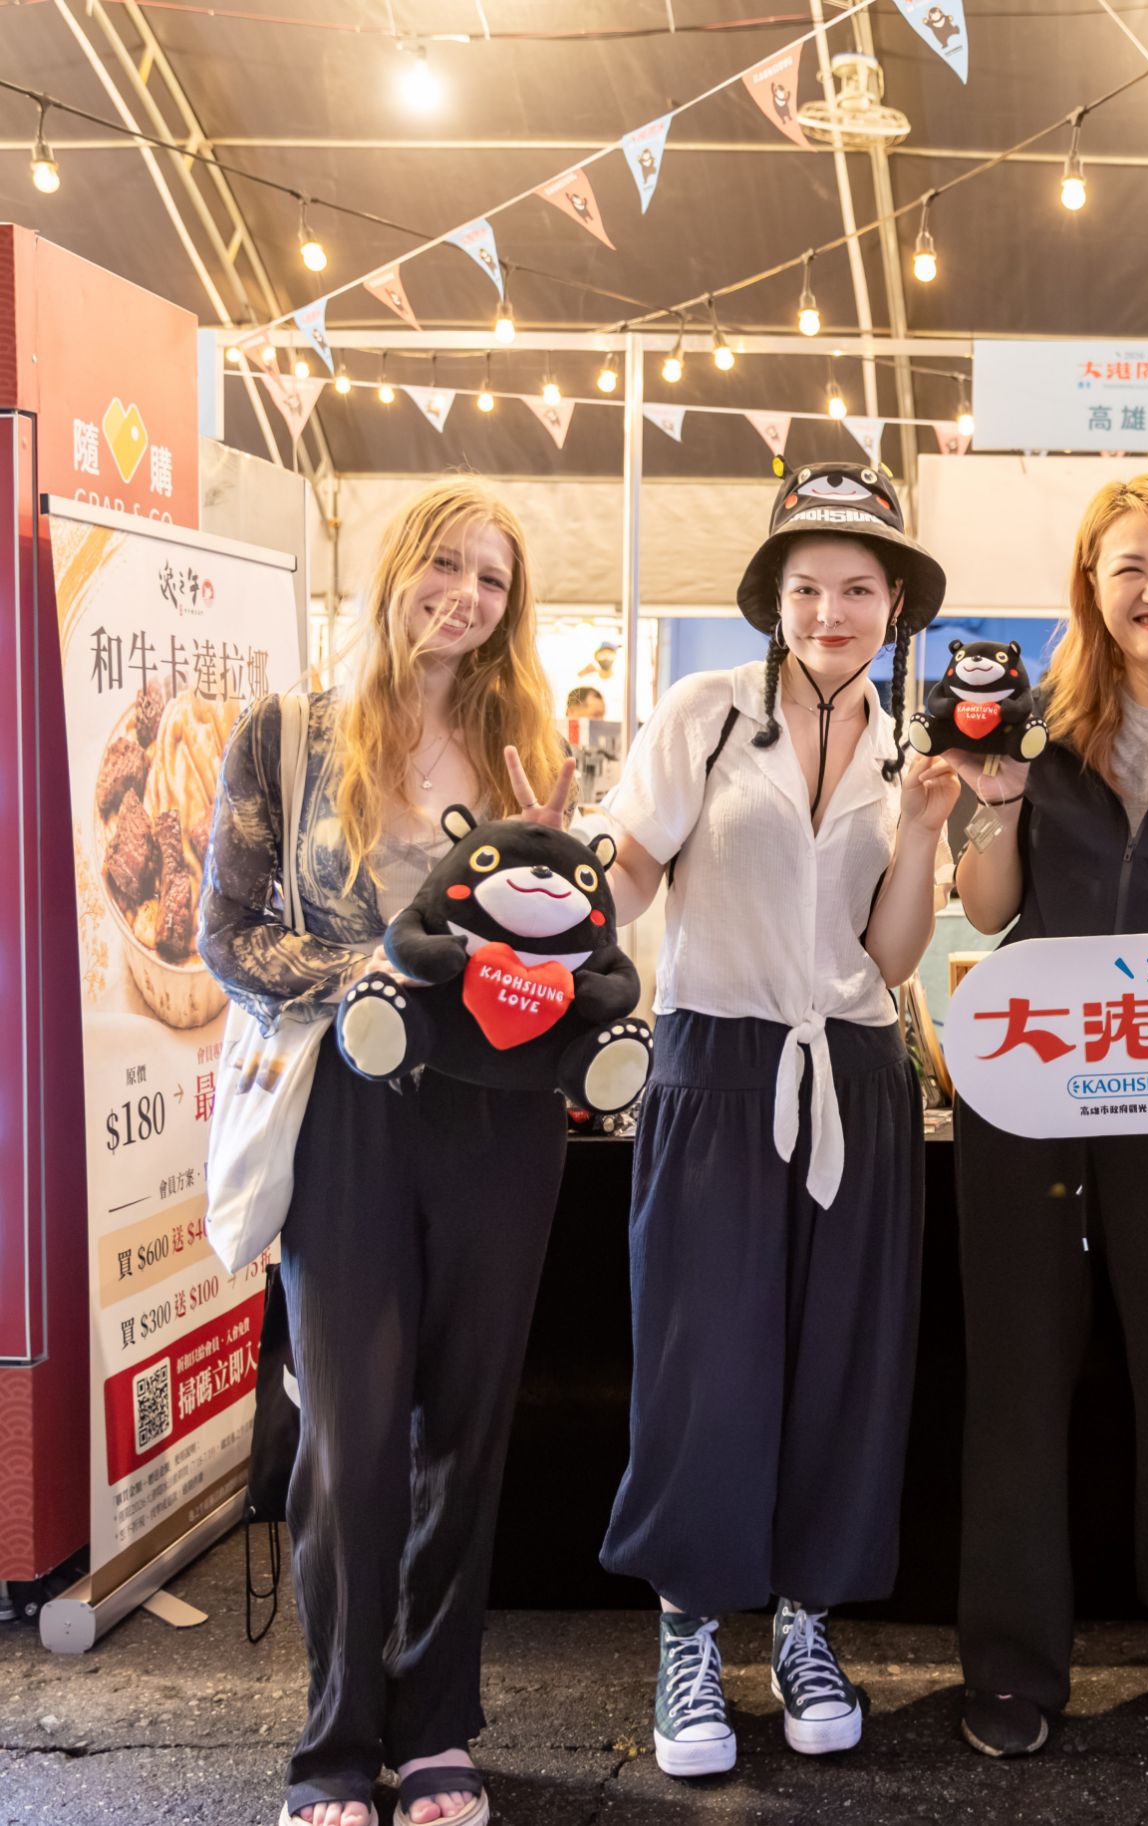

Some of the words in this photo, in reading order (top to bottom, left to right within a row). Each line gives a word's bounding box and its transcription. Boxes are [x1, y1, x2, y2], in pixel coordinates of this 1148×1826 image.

[480, 965, 564, 1002] KAOHSIUNG
[498, 989, 541, 1013] LOVE
[106, 1091, 166, 1155] $180
[118, 1249, 133, 1280] 買
[137, 1234, 169, 1271] $600
[172, 1225, 184, 1254] 送
[121, 1317, 136, 1350] 買
[140, 1301, 171, 1339] $300
[174, 1290, 187, 1319] 送
[189, 1275, 219, 1311] $100
[178, 1341, 261, 1420] 掃碼立即入
